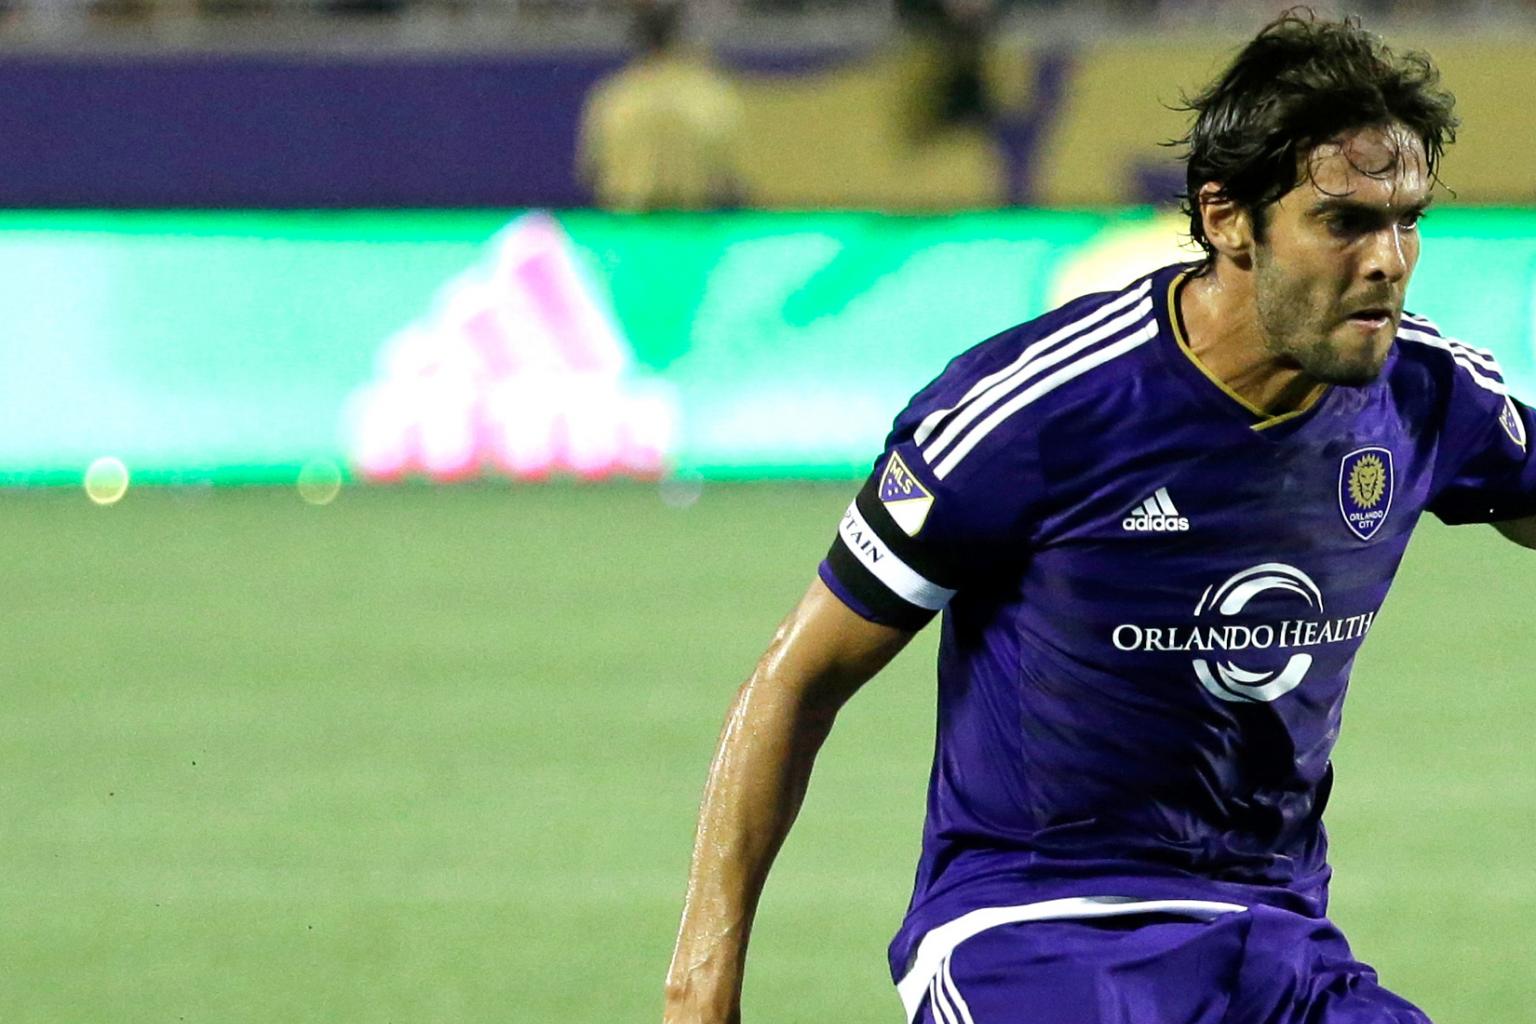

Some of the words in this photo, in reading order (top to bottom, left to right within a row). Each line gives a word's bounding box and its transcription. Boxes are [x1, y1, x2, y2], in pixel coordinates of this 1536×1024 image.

[890, 461, 913, 494] MLS
[1122, 514, 1190, 532] adidas
[1350, 511, 1384, 521] ORLANDO
[1359, 520, 1375, 529] CITY
[1111, 624, 1275, 651] ORLANDO
